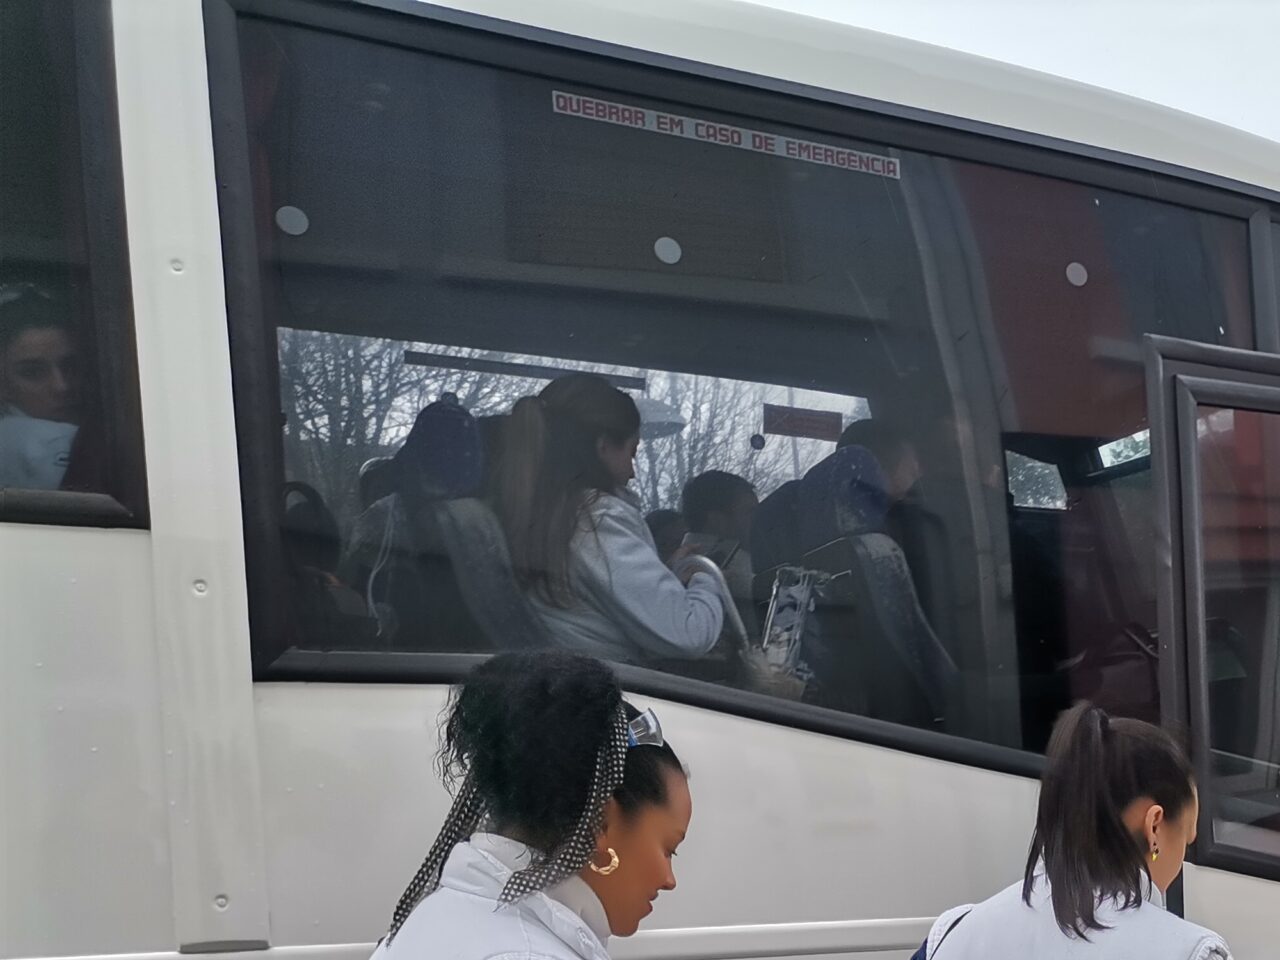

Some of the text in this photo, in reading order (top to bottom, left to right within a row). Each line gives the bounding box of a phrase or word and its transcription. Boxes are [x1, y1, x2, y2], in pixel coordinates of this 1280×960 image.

[555, 94, 898, 177] QUEBRAR EM CASO DE EMERGENCIA
